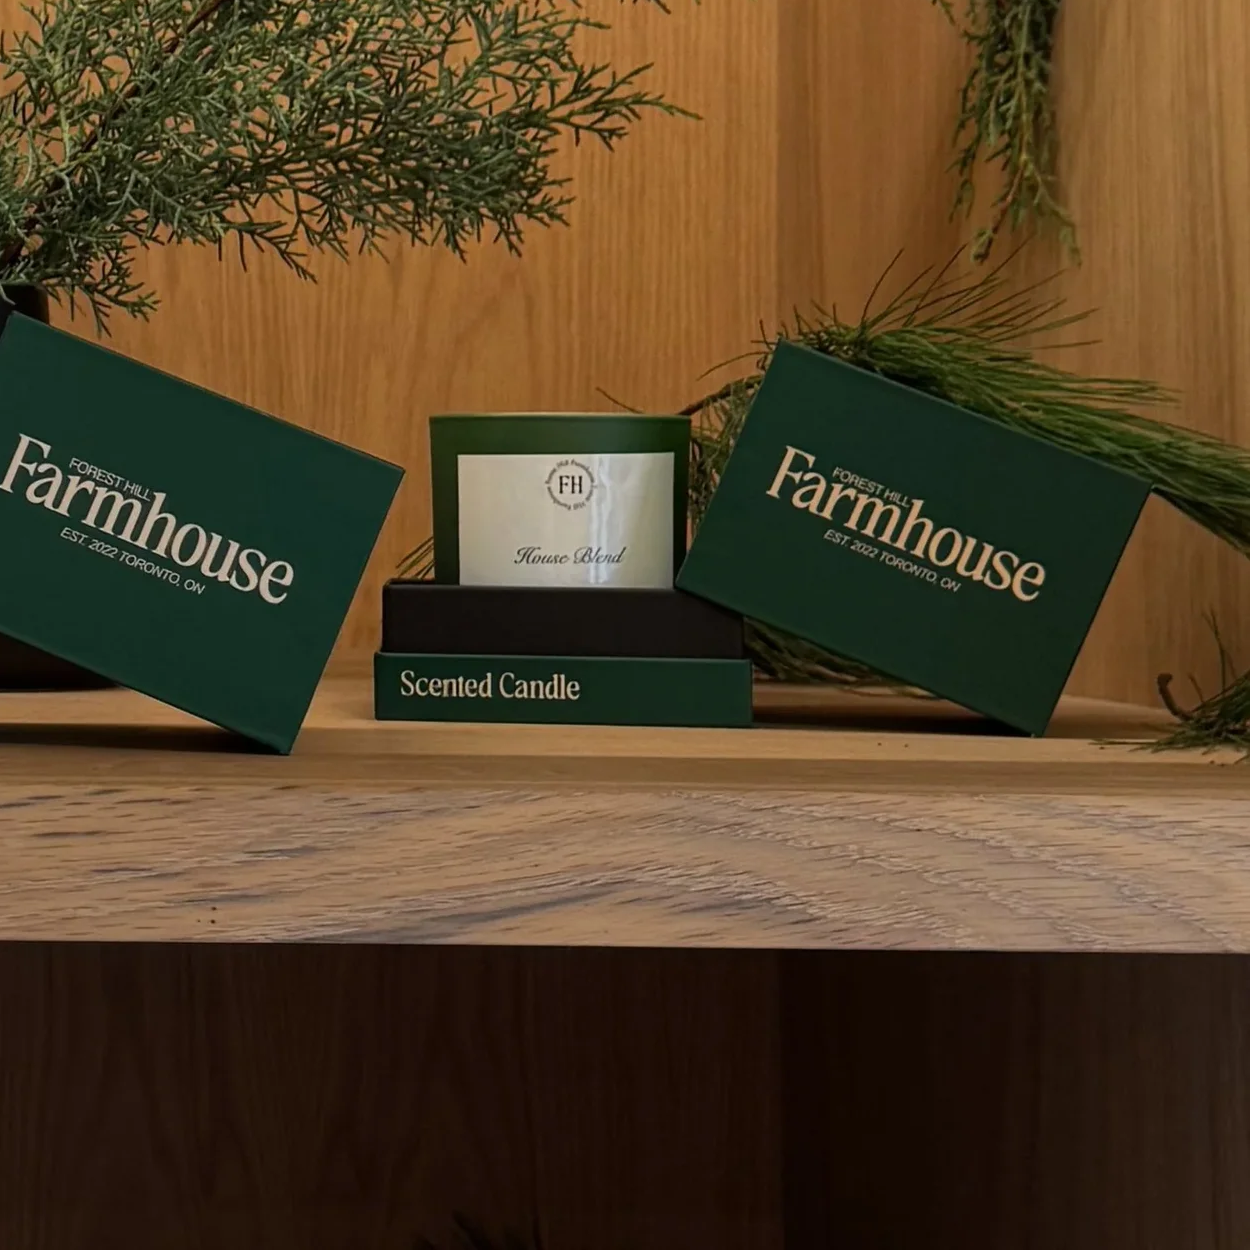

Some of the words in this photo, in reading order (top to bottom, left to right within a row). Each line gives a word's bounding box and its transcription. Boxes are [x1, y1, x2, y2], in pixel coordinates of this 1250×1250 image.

[69, 457, 123, 488] FOREST
[124, 480, 151, 502] HILL
[559, 475, 582, 495] FH
[832, 466, 884, 496] FOREST
[884, 488, 910, 508] HILL
[765, 445, 1046, 602] Farmhouse
[60, 527, 86, 547] EST.
[88, 538, 118, 559] 2022
[118, 550, 181, 587] TORONTO,
[184, 579, 206, 595] ON
[513, 546, 570, 565] House
[573, 546, 627, 565] Blend
[823, 529, 850, 548] EST.
[850, 539, 878, 559] 2022
[940, 576, 962, 593] ON
[400, 669, 493, 698] Scented
[499, 672, 581, 700] Candle
